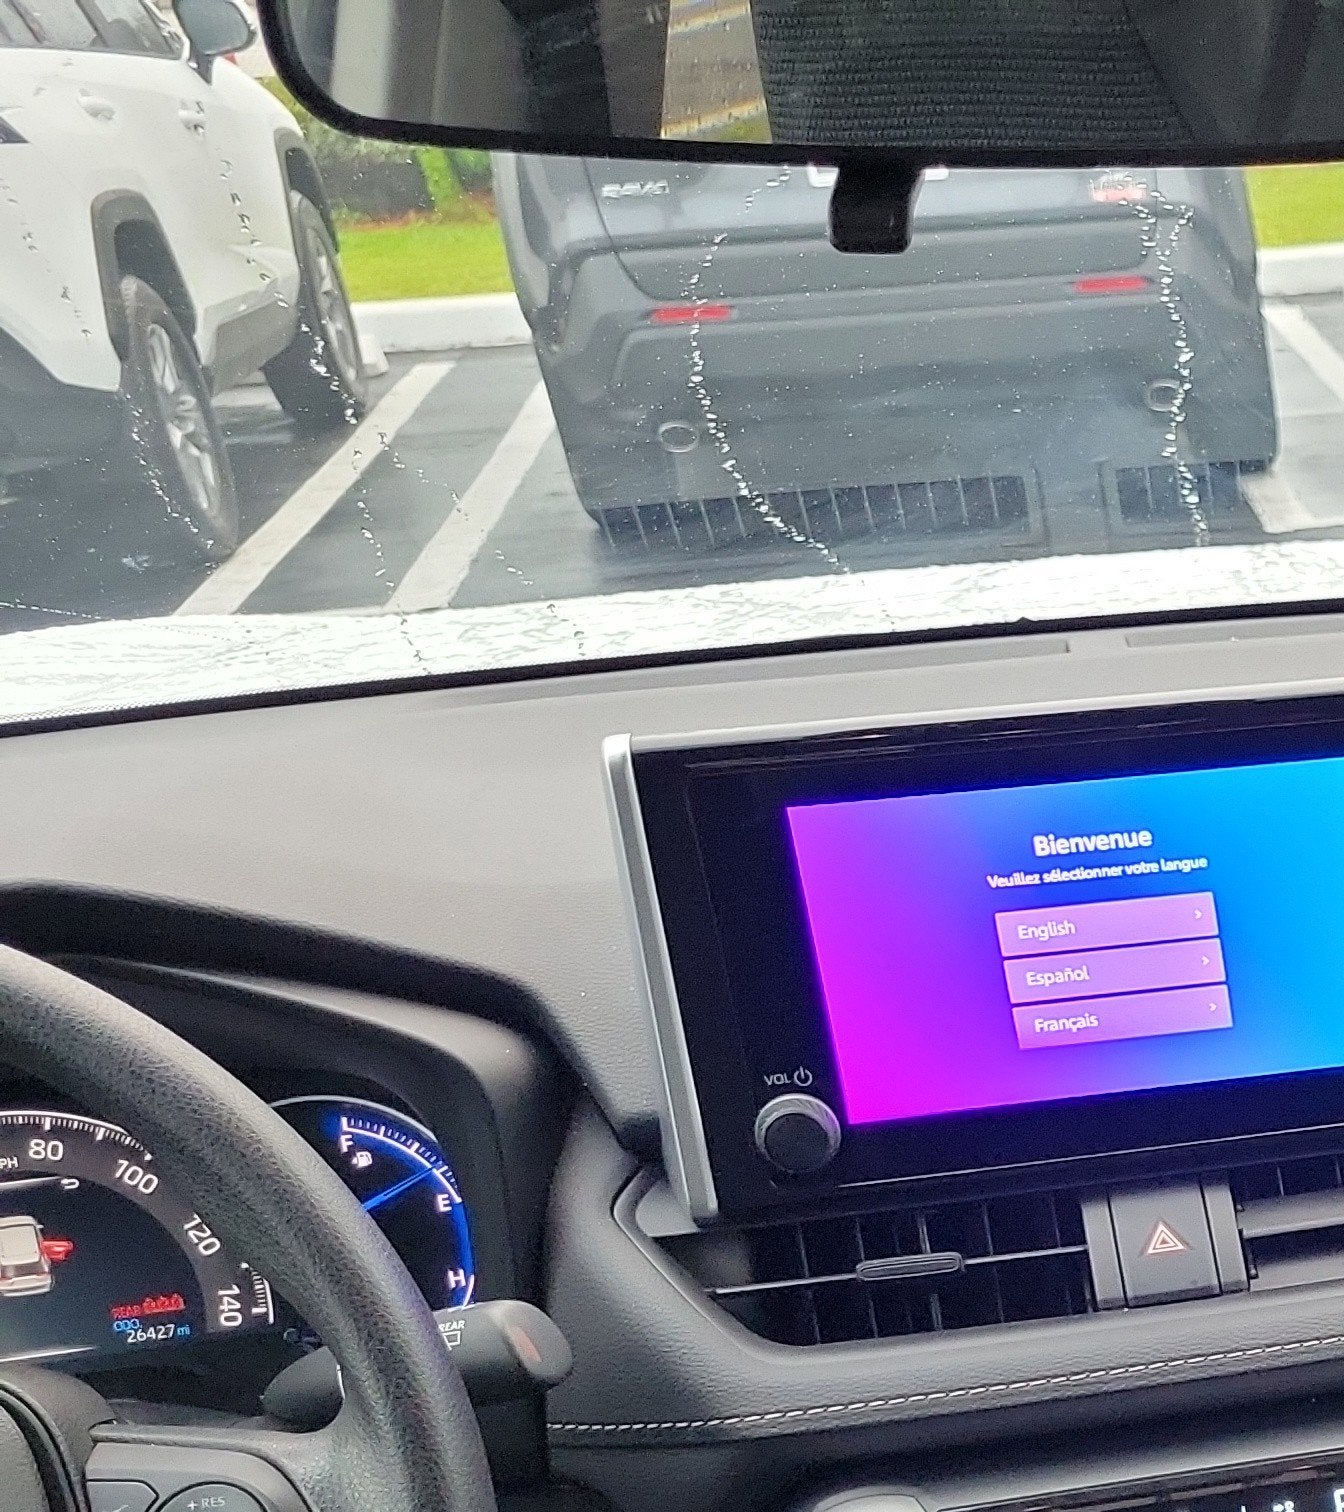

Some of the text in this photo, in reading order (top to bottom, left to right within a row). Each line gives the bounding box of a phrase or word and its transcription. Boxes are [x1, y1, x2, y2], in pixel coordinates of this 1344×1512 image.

[1032, 829, 1153, 857] Bienvenue
[986, 856, 1209, 889] Veuillez sélectionner votre langue
[1017, 919, 1077, 942] English
[1025, 965, 1091, 987] Español
[1034, 1013, 1099, 1034] Français
[763, 1072, 792, 1086] VOL
[28, 1138, 64, 1161] 80
[340, 1134, 354, 1153] F
[113, 1158, 159, 1195] 100
[437, 1194, 452, 1213] E
[182, 1212, 222, 1257] 120
[447, 1269, 466, 1289] H
[217, 1284, 244, 1327] 140
[126, 1323, 191, 1343] 26427 mi
[201, 1496, 226, 1508] RES
